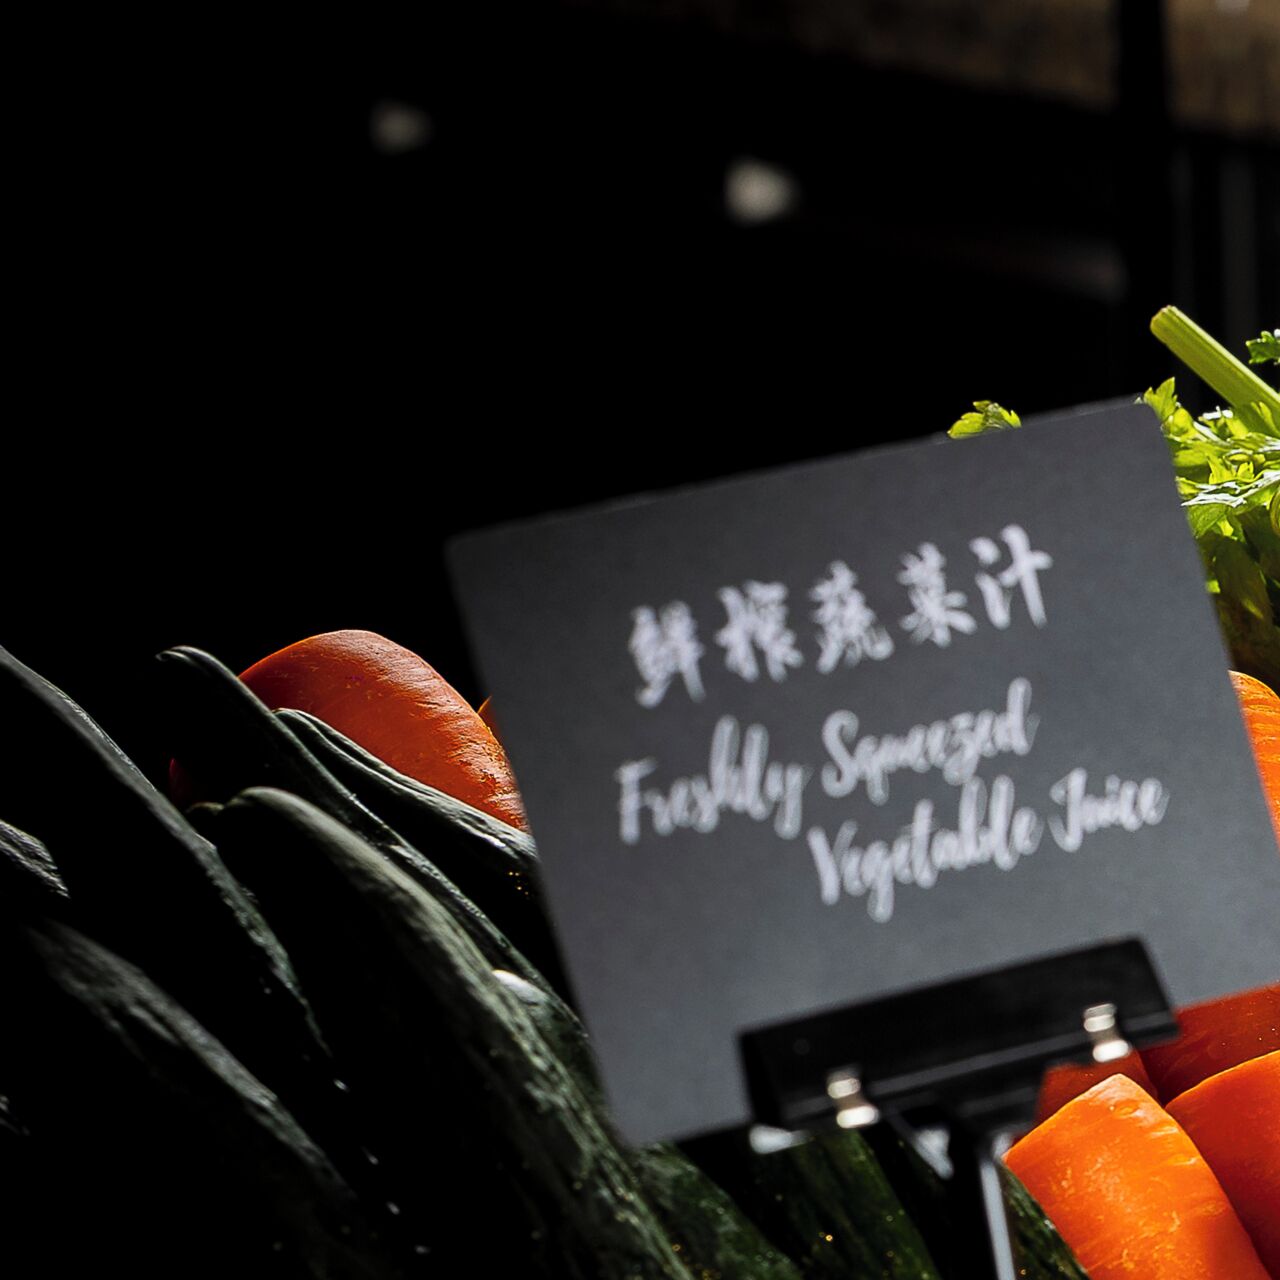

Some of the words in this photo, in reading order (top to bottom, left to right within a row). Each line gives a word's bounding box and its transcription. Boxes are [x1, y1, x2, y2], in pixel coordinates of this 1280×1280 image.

[615, 714, 812, 846] Freshly
[821, 677, 1041, 805] Squeezed
[807, 775, 1043, 923] Vegetable
[1049, 767, 1169, 852] Juice
